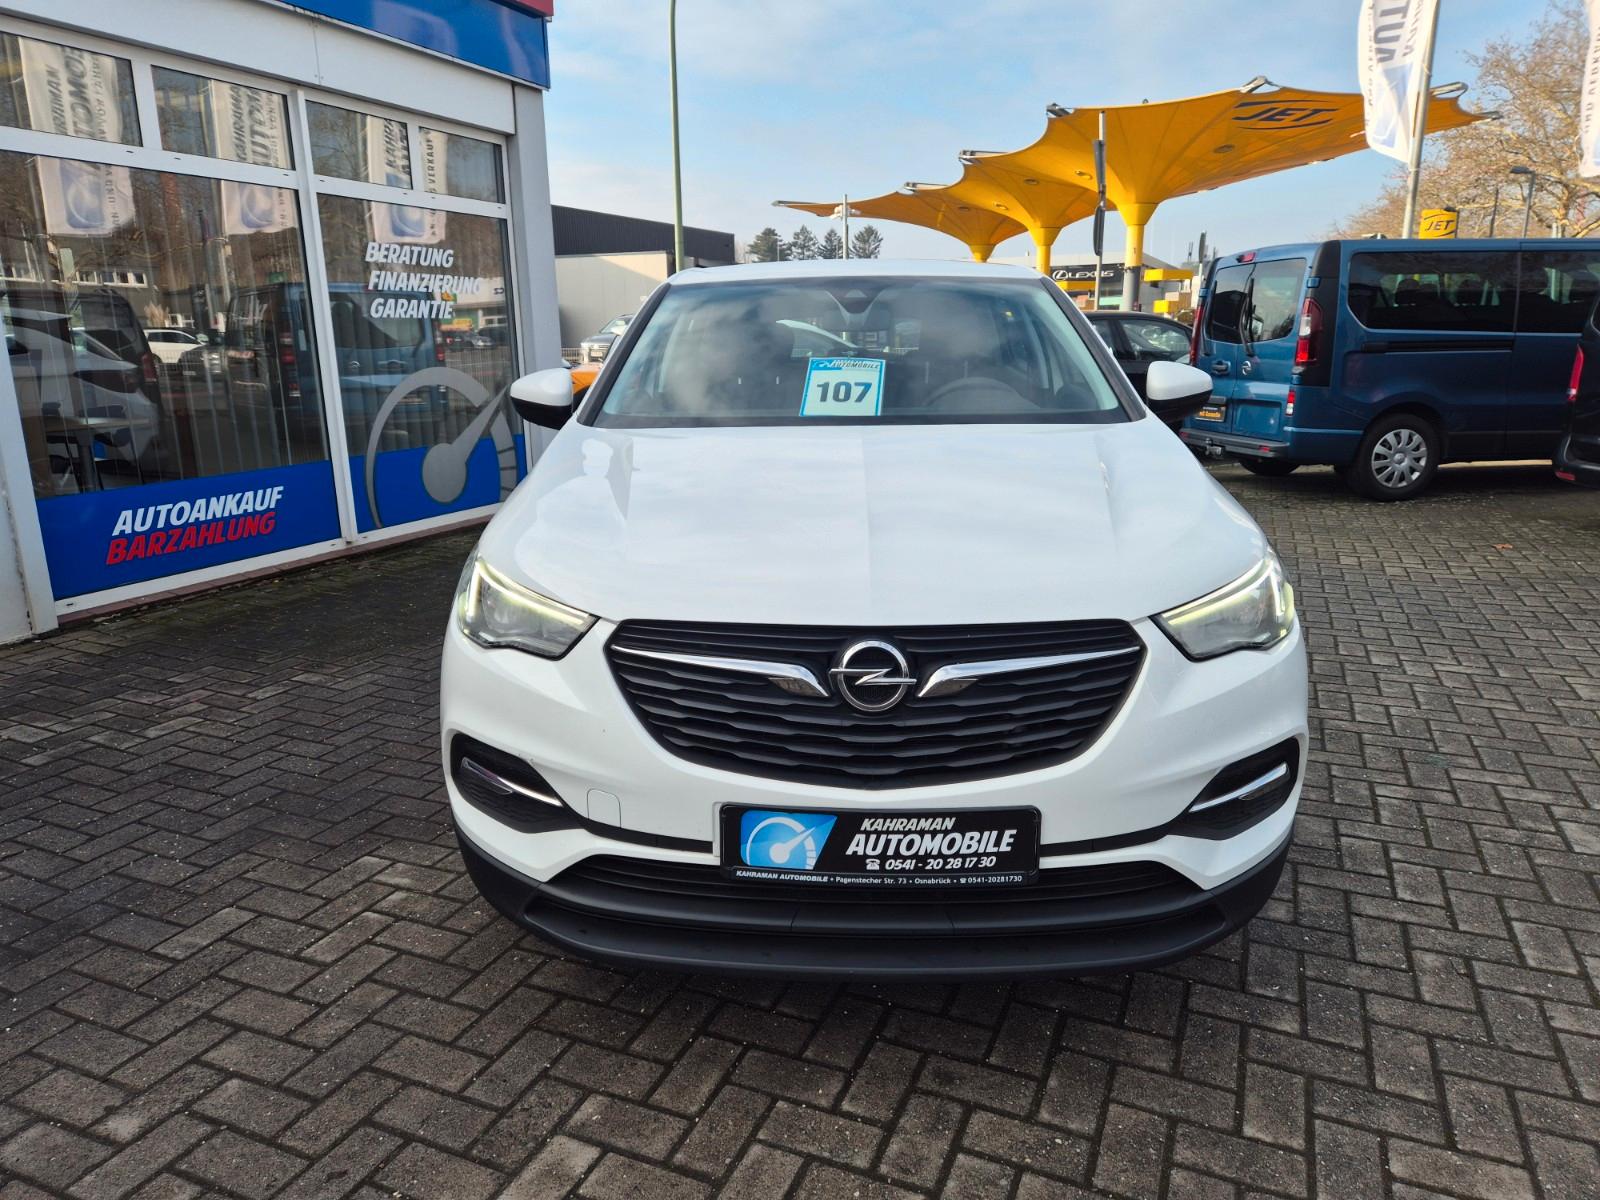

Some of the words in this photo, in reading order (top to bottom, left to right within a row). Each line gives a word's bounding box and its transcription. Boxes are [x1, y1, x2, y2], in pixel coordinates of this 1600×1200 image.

[1232, 107, 1340, 122] JET
[1425, 219, 1454, 232] JET
[365, 241, 454, 268] BERATUNG
[370, 298, 453, 318] GARANTIE
[817, 382, 872, 402] 107
[112, 486, 284, 536] AUTOANKAUF
[106, 511, 276, 565] BARZAHLUNG
[860, 817, 956, 831] KAHRAMAN
[845, 829, 1017, 856] AUTOMOBILE
[885, 859, 915, 870] 0541
[925, 859, 943, 870] 20
[944, 858, 961, 869] 28
[964, 857, 977, 869] 17
[978, 856, 997, 867] 30
[736, 870, 778, 880] KAHRAMAN
[779, 873, 828, 882] AUTOMOBILE
[836, 876, 881, 885] Pagenstecher
